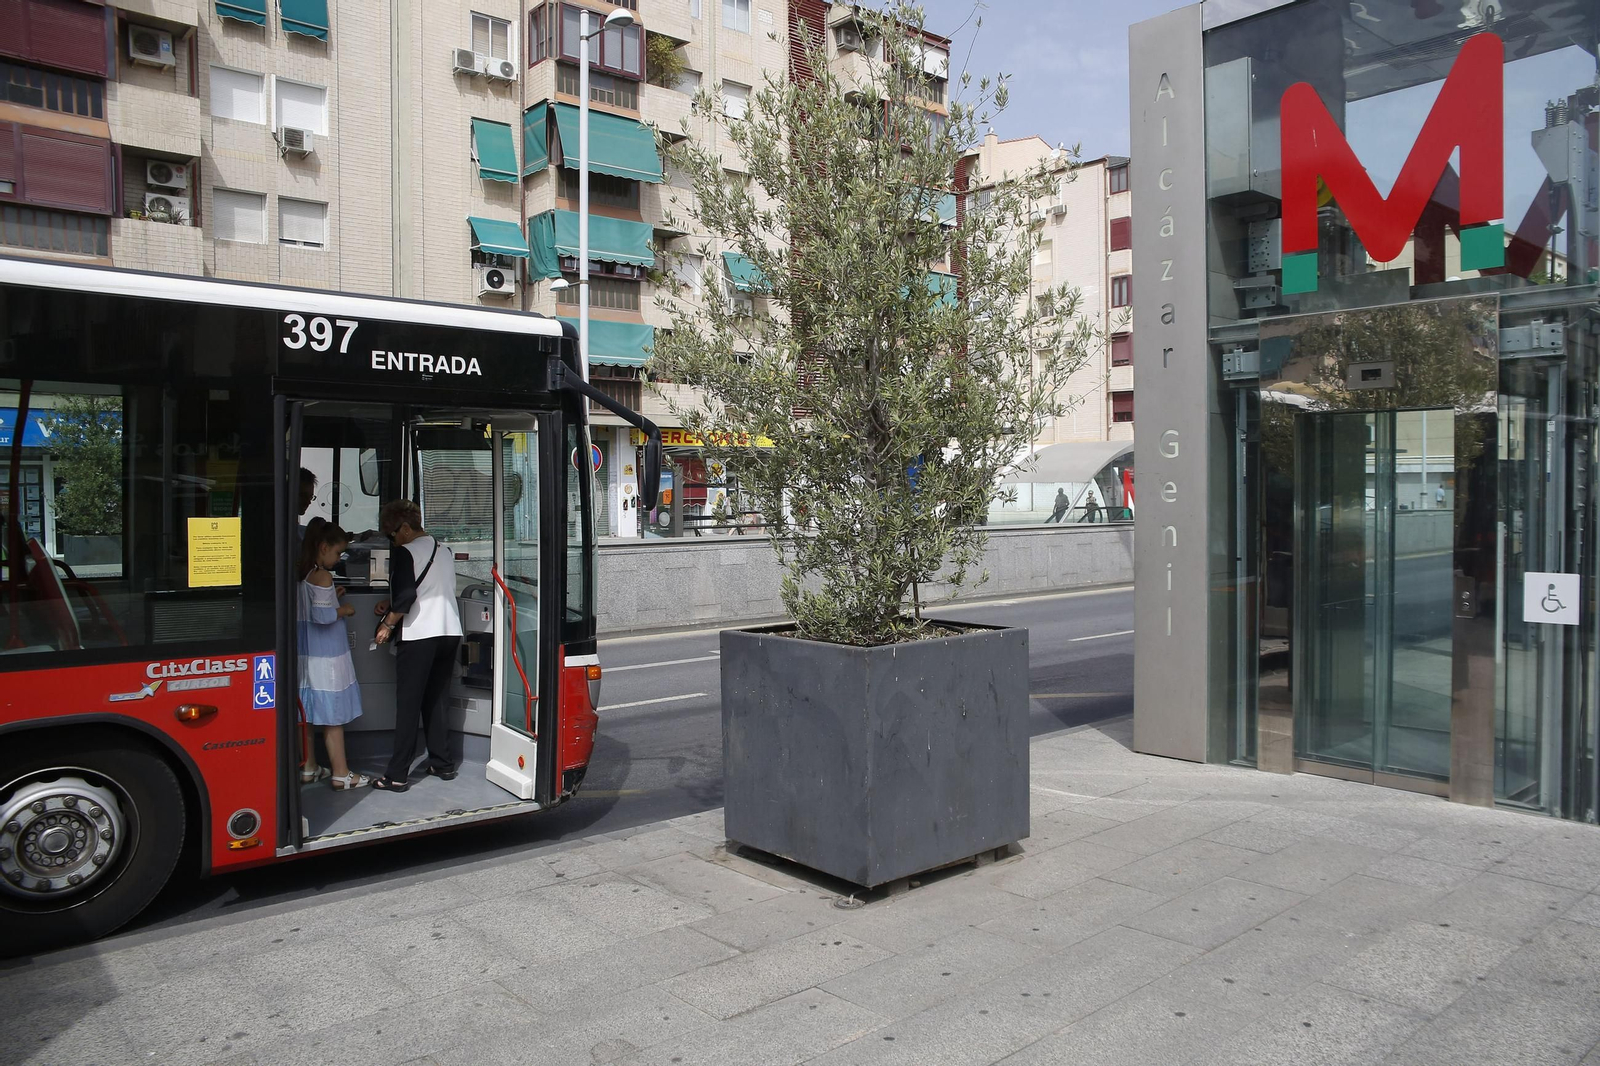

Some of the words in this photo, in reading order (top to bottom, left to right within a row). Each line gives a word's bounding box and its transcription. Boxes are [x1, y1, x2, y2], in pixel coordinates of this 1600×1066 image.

[1280, 32, 1505, 295] M
[1154, 72, 1177, 369] Alcázar
[283, 314, 359, 354] 397
[371, 350, 482, 376] ENTRADA
[1158, 429, 1181, 637] Genil
[146, 658, 248, 679] CityClass
[170, 678, 230, 690] CURSOR
[202, 737, 266, 751] Castrosua
